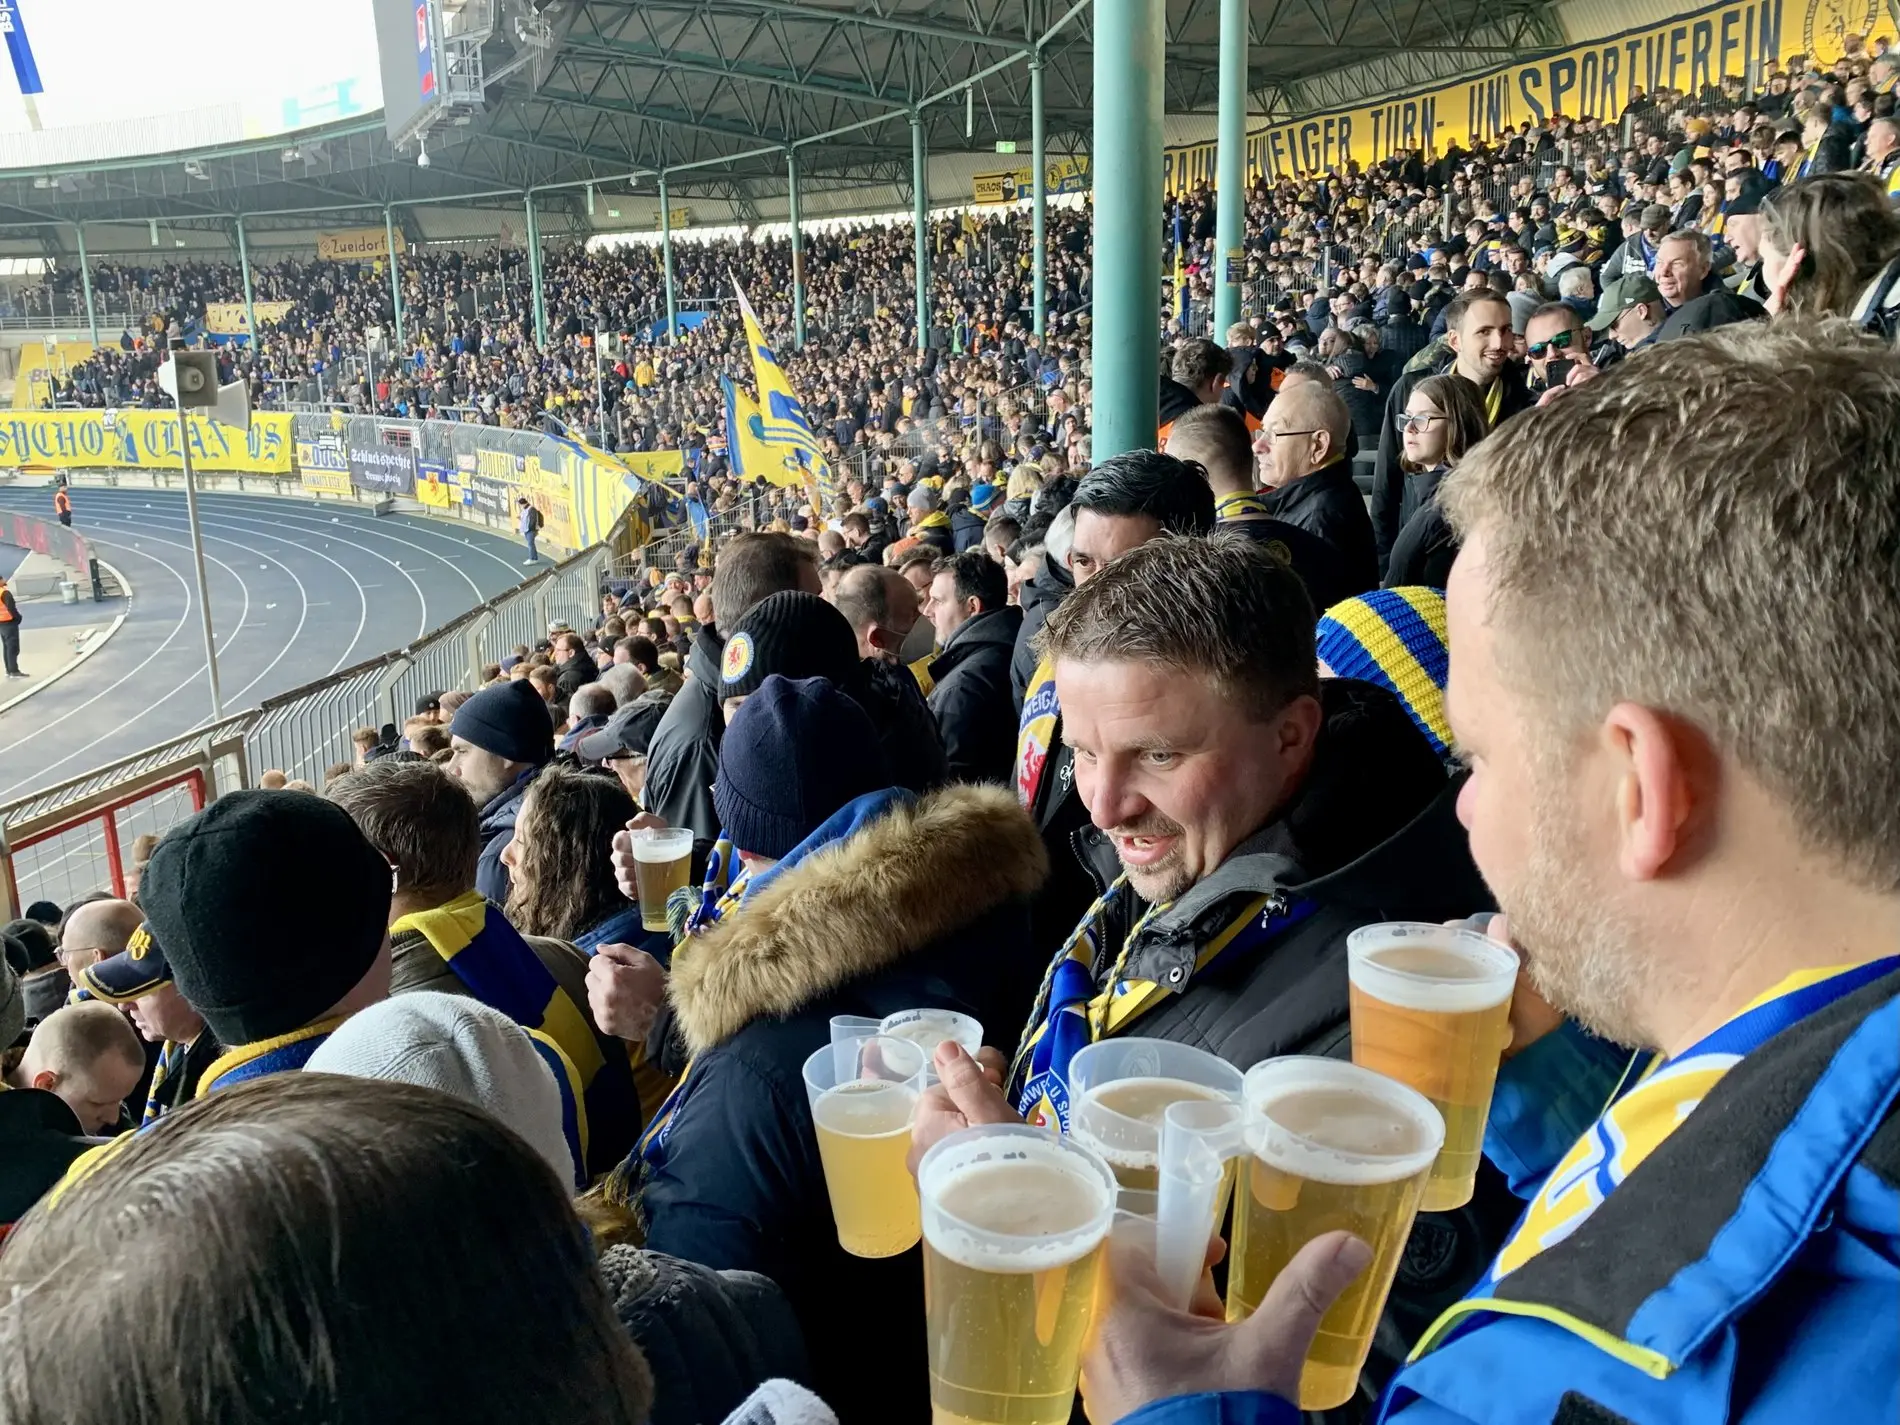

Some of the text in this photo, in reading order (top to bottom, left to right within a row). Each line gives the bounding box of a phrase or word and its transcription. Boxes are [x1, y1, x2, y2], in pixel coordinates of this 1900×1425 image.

[1164, 116, 1352, 195] RAUNHWEIGER
[1371, 96, 1445, 168] TURN-
[1468, 74, 1513, 142] UND
[1518, 0, 1783, 124] SPORTVEREIN
[143, 419, 230, 458] CLAN
[246, 421, 282, 461] BS
[1018, 1080, 1047, 1117] CHW
